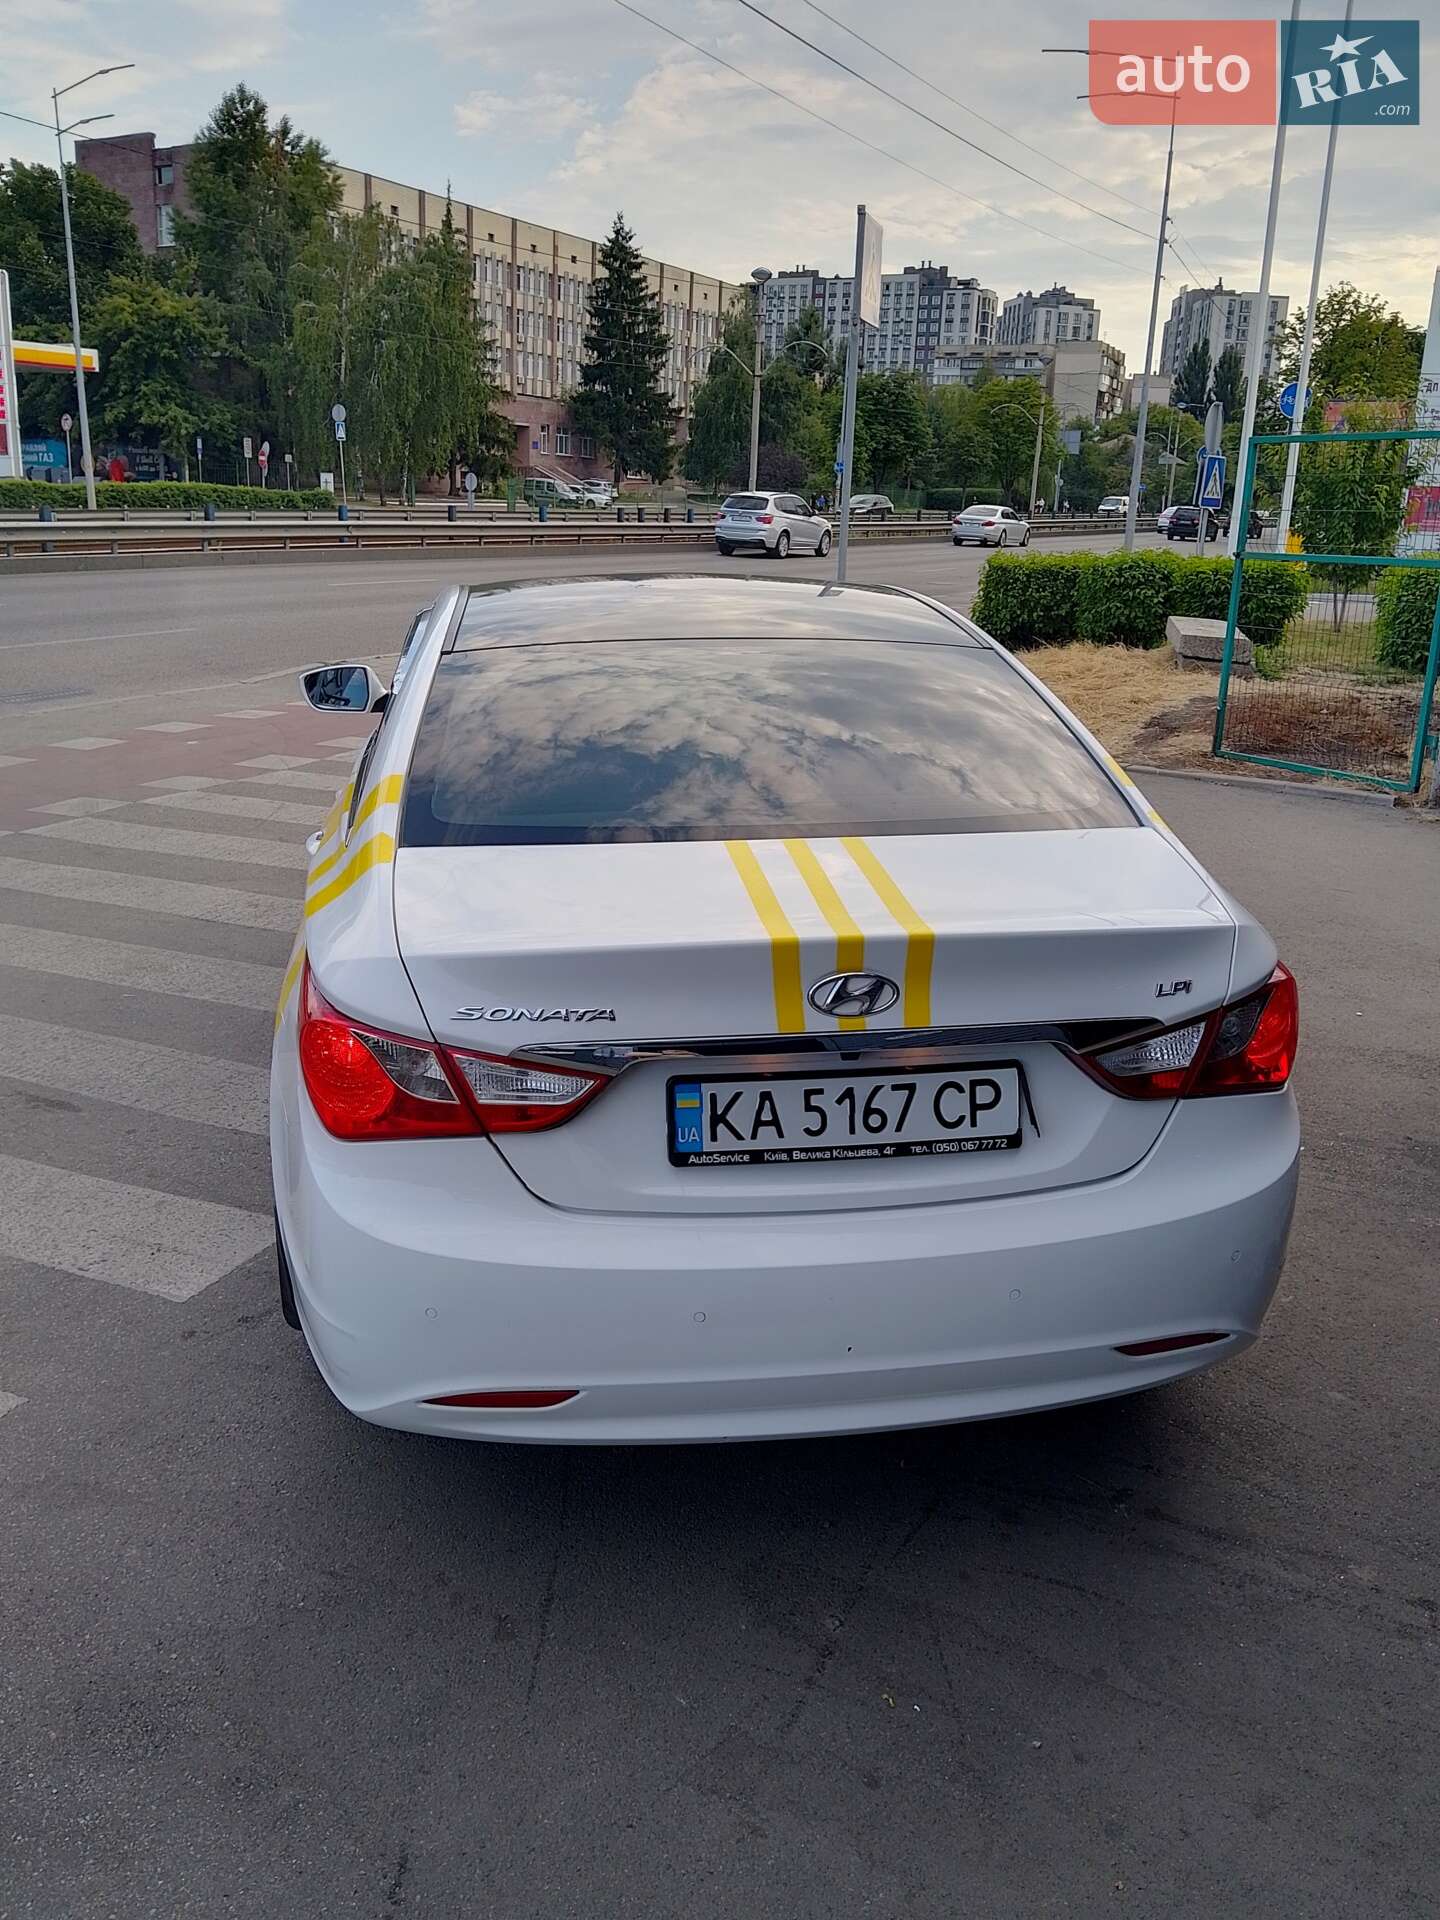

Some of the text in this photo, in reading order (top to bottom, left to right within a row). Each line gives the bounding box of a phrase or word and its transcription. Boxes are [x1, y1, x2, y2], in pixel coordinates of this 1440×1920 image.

[450, 1006, 617, 1022] SONATA
[708, 1078, 1002, 1143] KA 5167 CP
[678, 1127, 700, 1143] UA
[688, 1153, 750, 1164] AutoService
[793, 1149, 831, 1160] Велика
[932, 1142, 960, 1153] (050)
[961, 1141, 979, 1151] 067
[981, 1140, 994, 1150] 77
[995, 1138, 1008, 1148] 72
